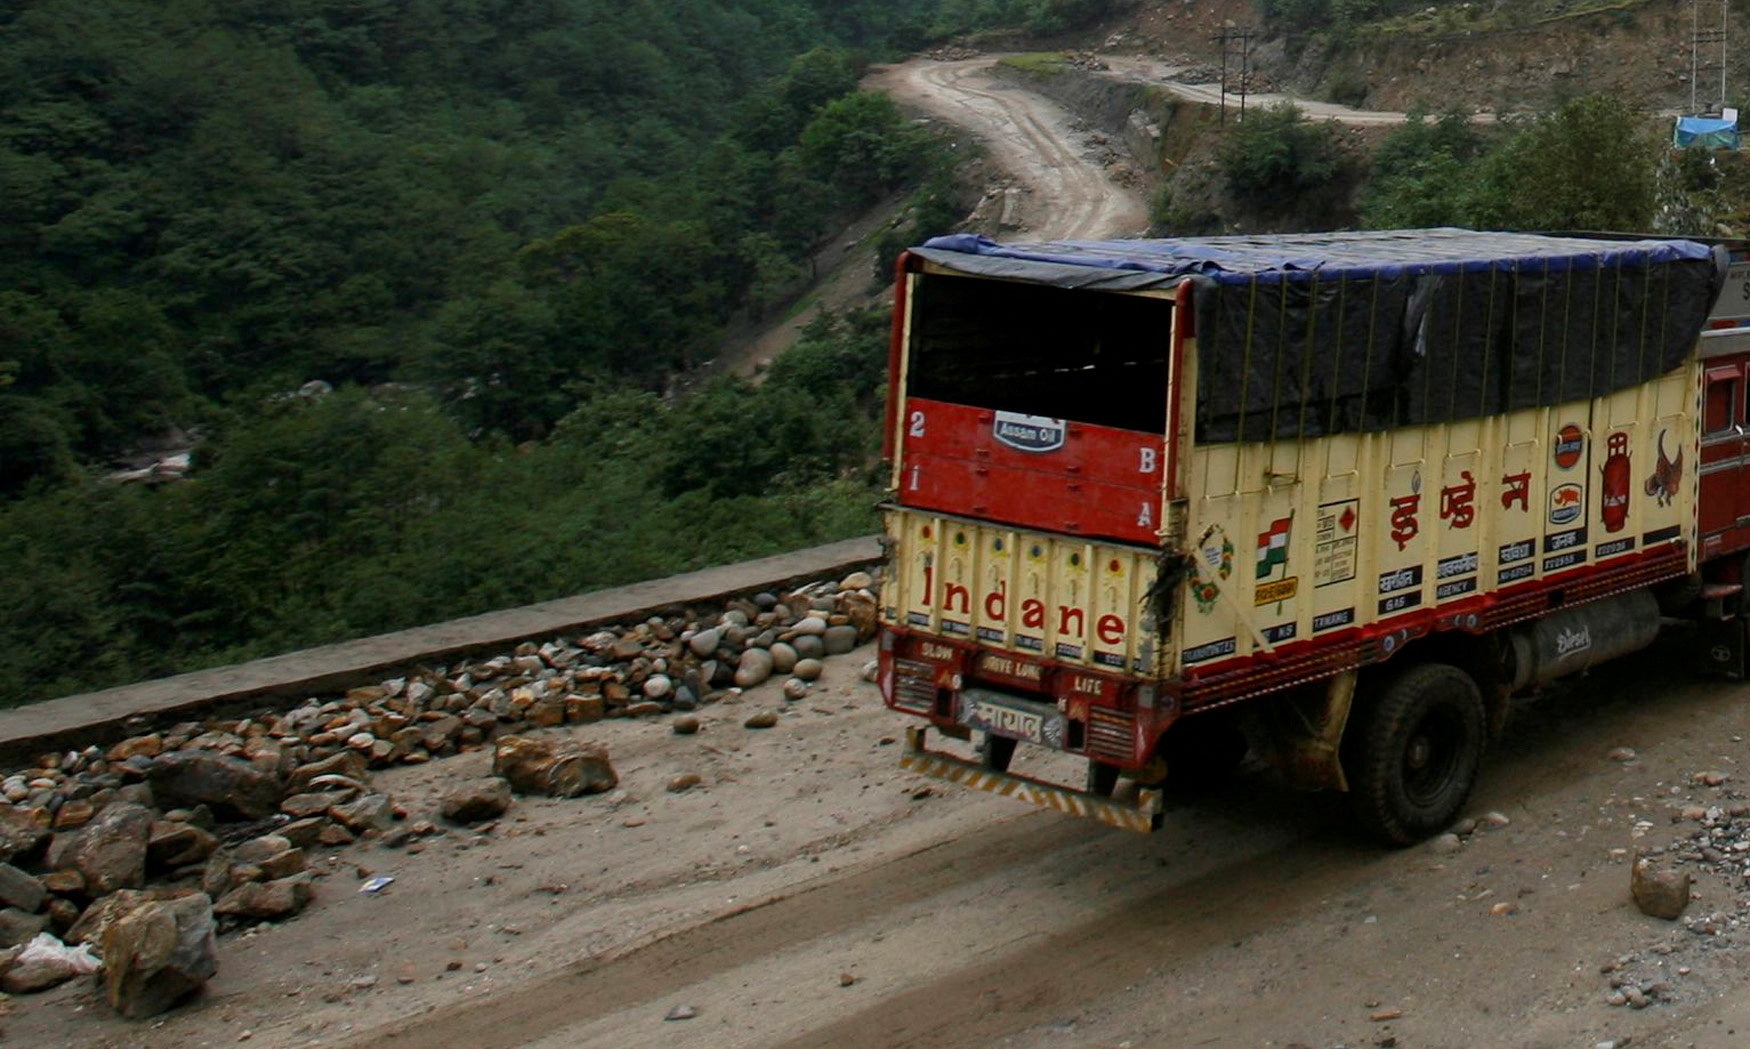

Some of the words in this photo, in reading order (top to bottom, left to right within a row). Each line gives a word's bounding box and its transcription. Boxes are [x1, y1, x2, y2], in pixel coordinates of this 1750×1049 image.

[910, 411, 926, 437] 2
[1001, 422, 1036, 440] Assam
[1040, 428, 1055, 443] Oil
[1139, 447, 1156, 473] B
[1137, 502, 1151, 526] A
[921, 566, 1125, 645] Indane
[1386, 596, 1407, 611] GAS
[921, 641, 954, 661] SLOW
